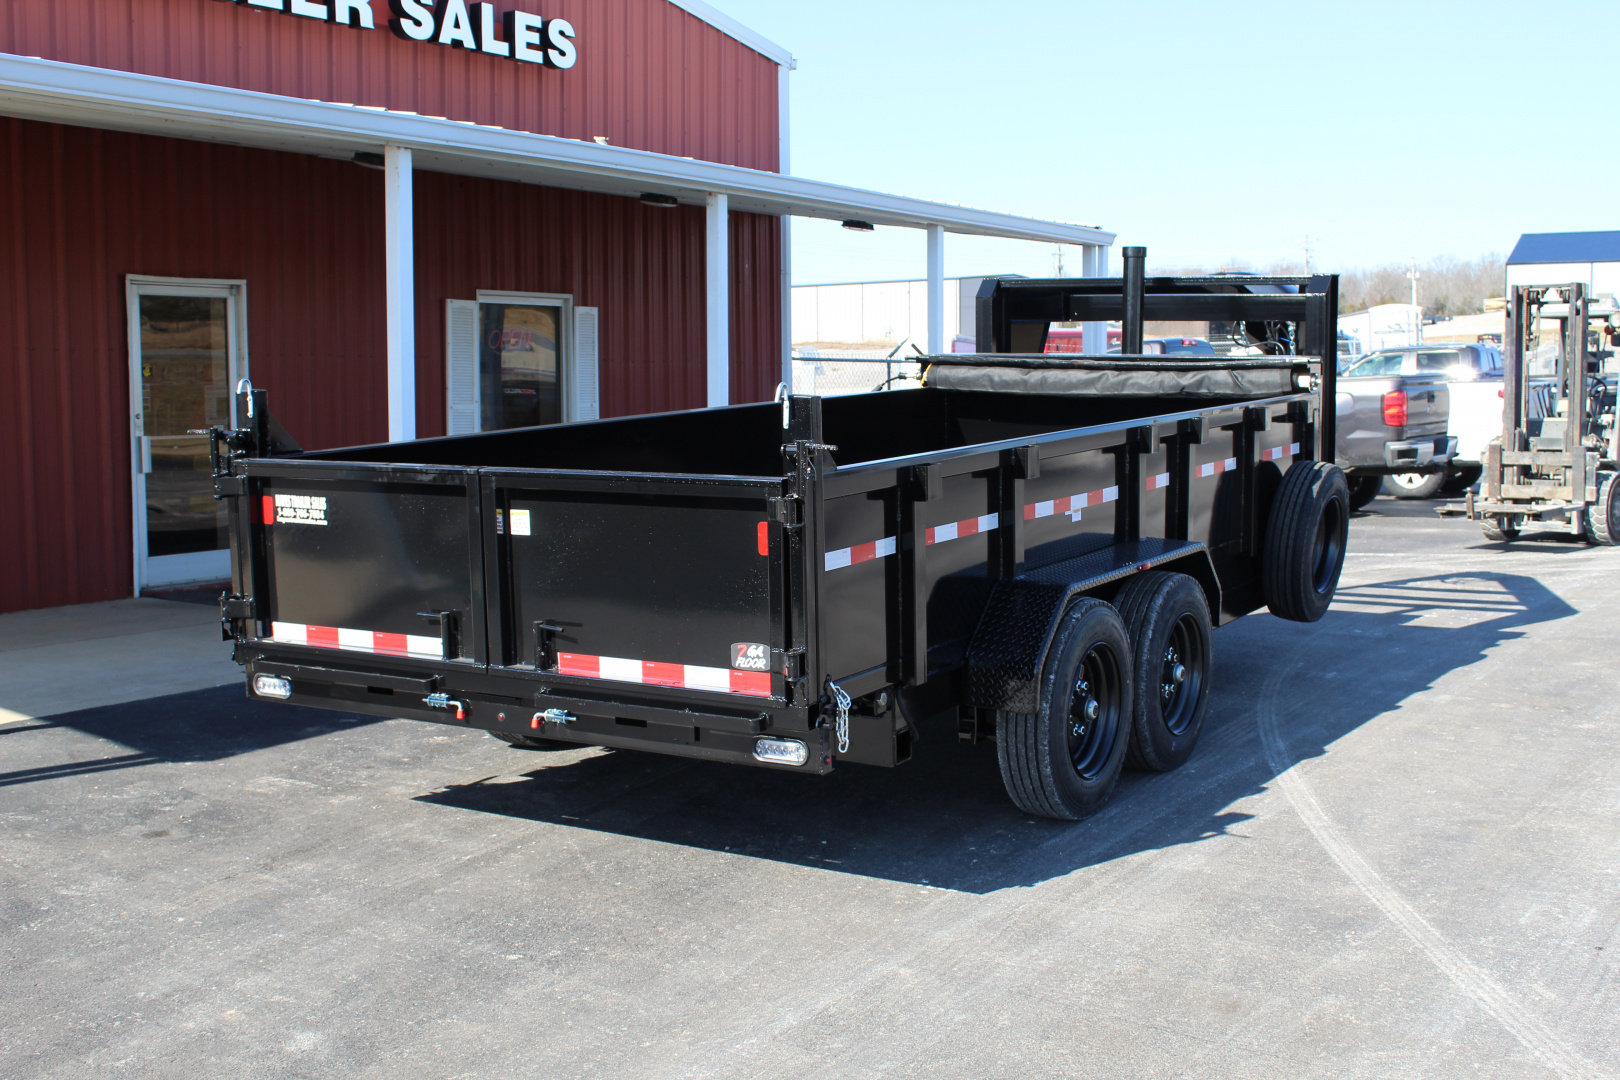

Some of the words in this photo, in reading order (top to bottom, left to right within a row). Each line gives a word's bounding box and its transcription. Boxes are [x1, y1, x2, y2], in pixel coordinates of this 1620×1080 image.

[398, 0, 577, 69] SALES
[489, 329, 531, 349] OPEN
[737, 644, 748, 658] 7
[747, 644, 764, 658] GA
[735, 657, 767, 669] FLOOR
